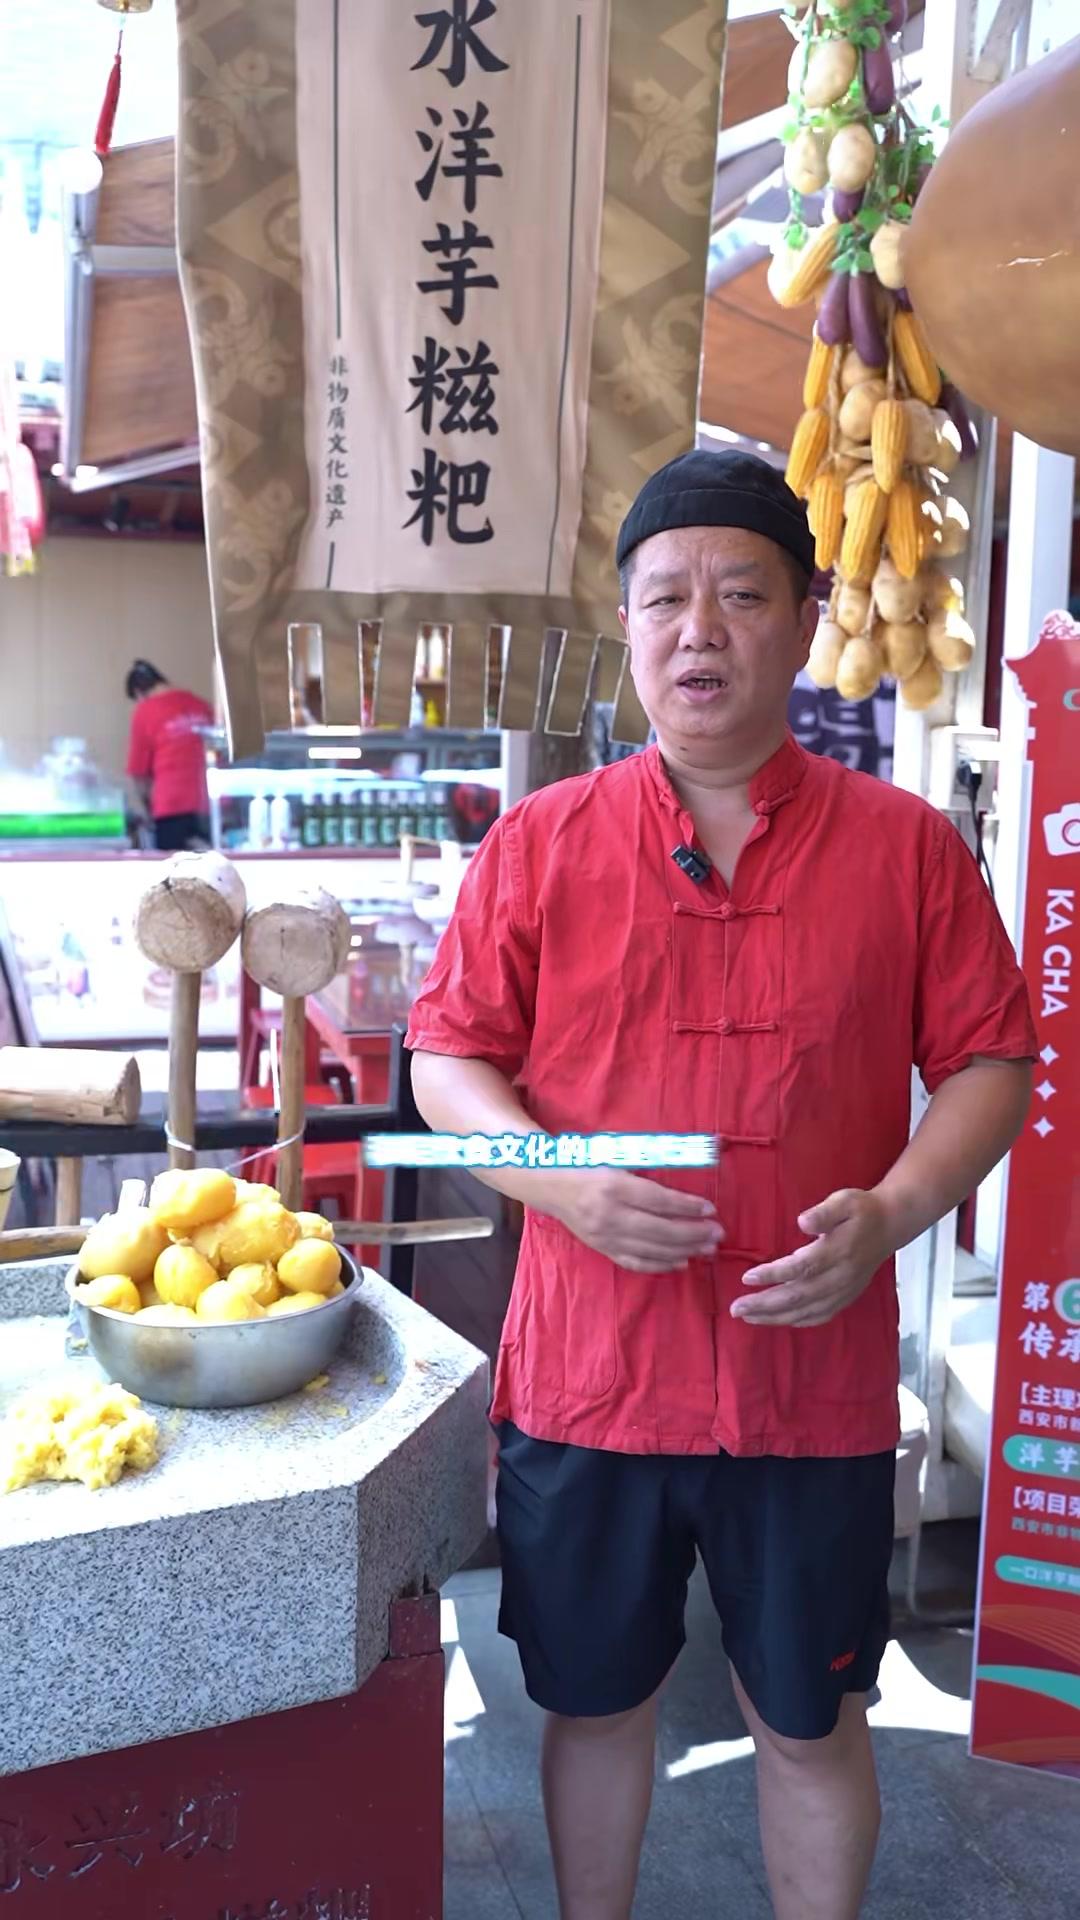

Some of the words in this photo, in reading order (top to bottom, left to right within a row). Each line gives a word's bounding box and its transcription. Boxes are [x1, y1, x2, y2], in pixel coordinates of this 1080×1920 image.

[402, 0, 510, 547] 水洋芋糍粑
[326, 355, 350, 529] 非物质文化遗产
[1045, 888, 1075, 935] KA
[1040, 944, 1072, 1018] CHA
[1021, 1381, 1080, 1411] 【主理
[1019, 1442, 1079, 1473] 洋芋
